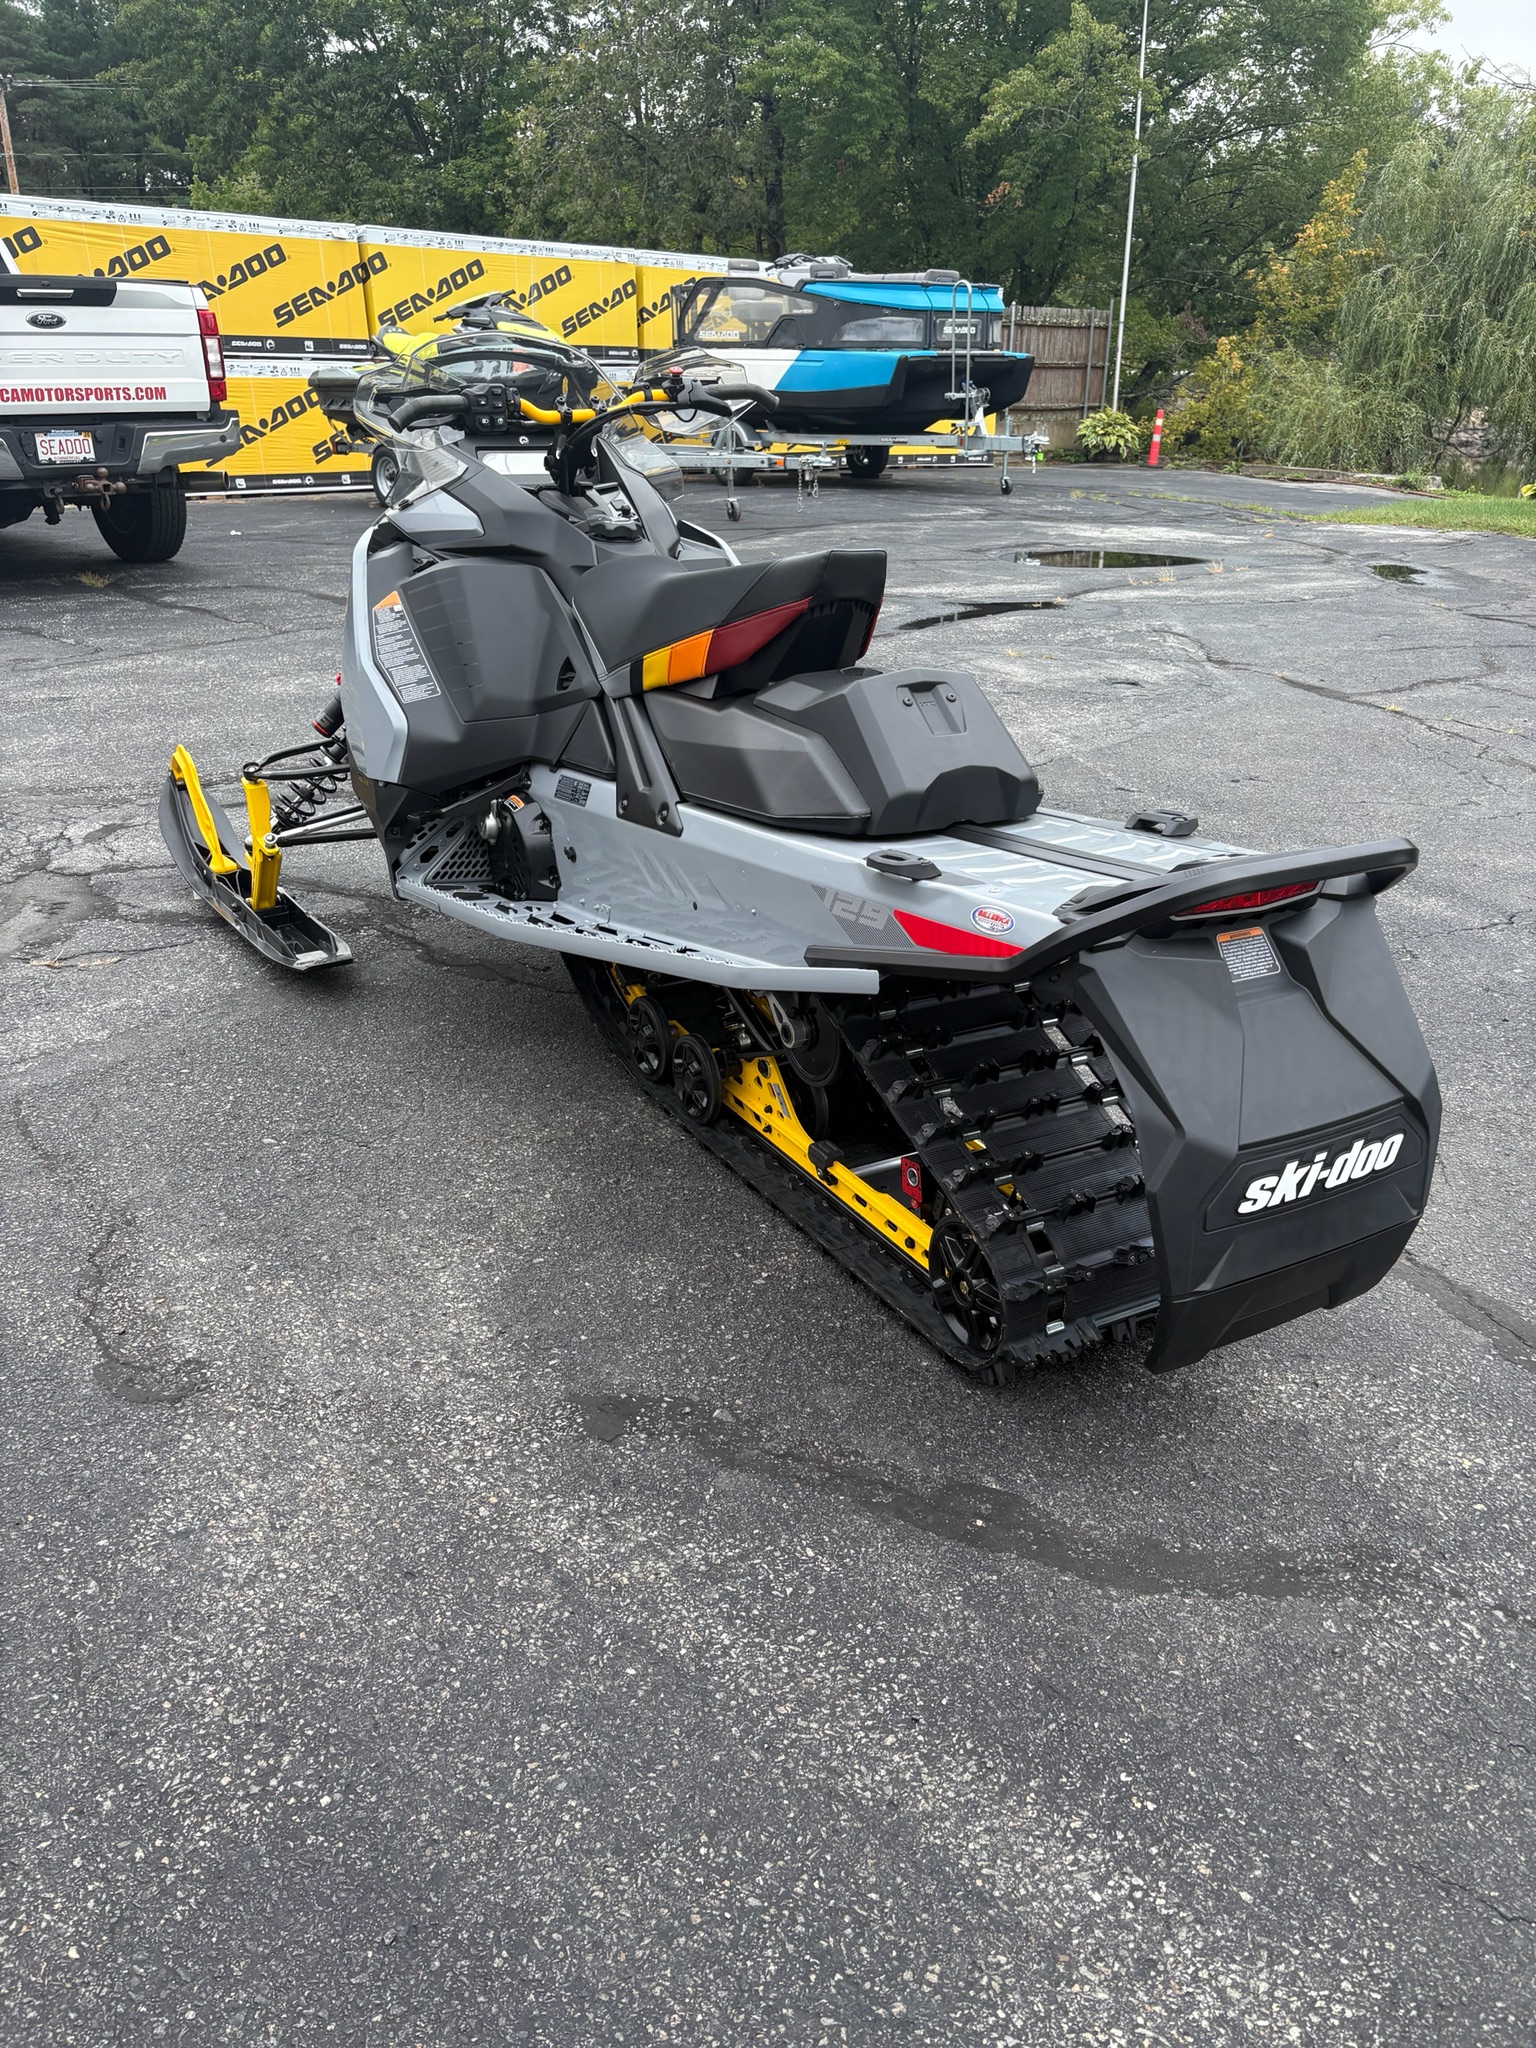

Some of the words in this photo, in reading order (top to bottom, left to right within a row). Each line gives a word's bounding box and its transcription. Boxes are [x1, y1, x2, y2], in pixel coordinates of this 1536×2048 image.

[36, 314, 58, 325] Ford
[75, 351, 180, 364] DUTY
[0, 386, 167, 403] CAMOTORSPORTS.COM
[39, 438, 91, 455] SEADOO
[1237, 1133, 1406, 1214] ski-doo
